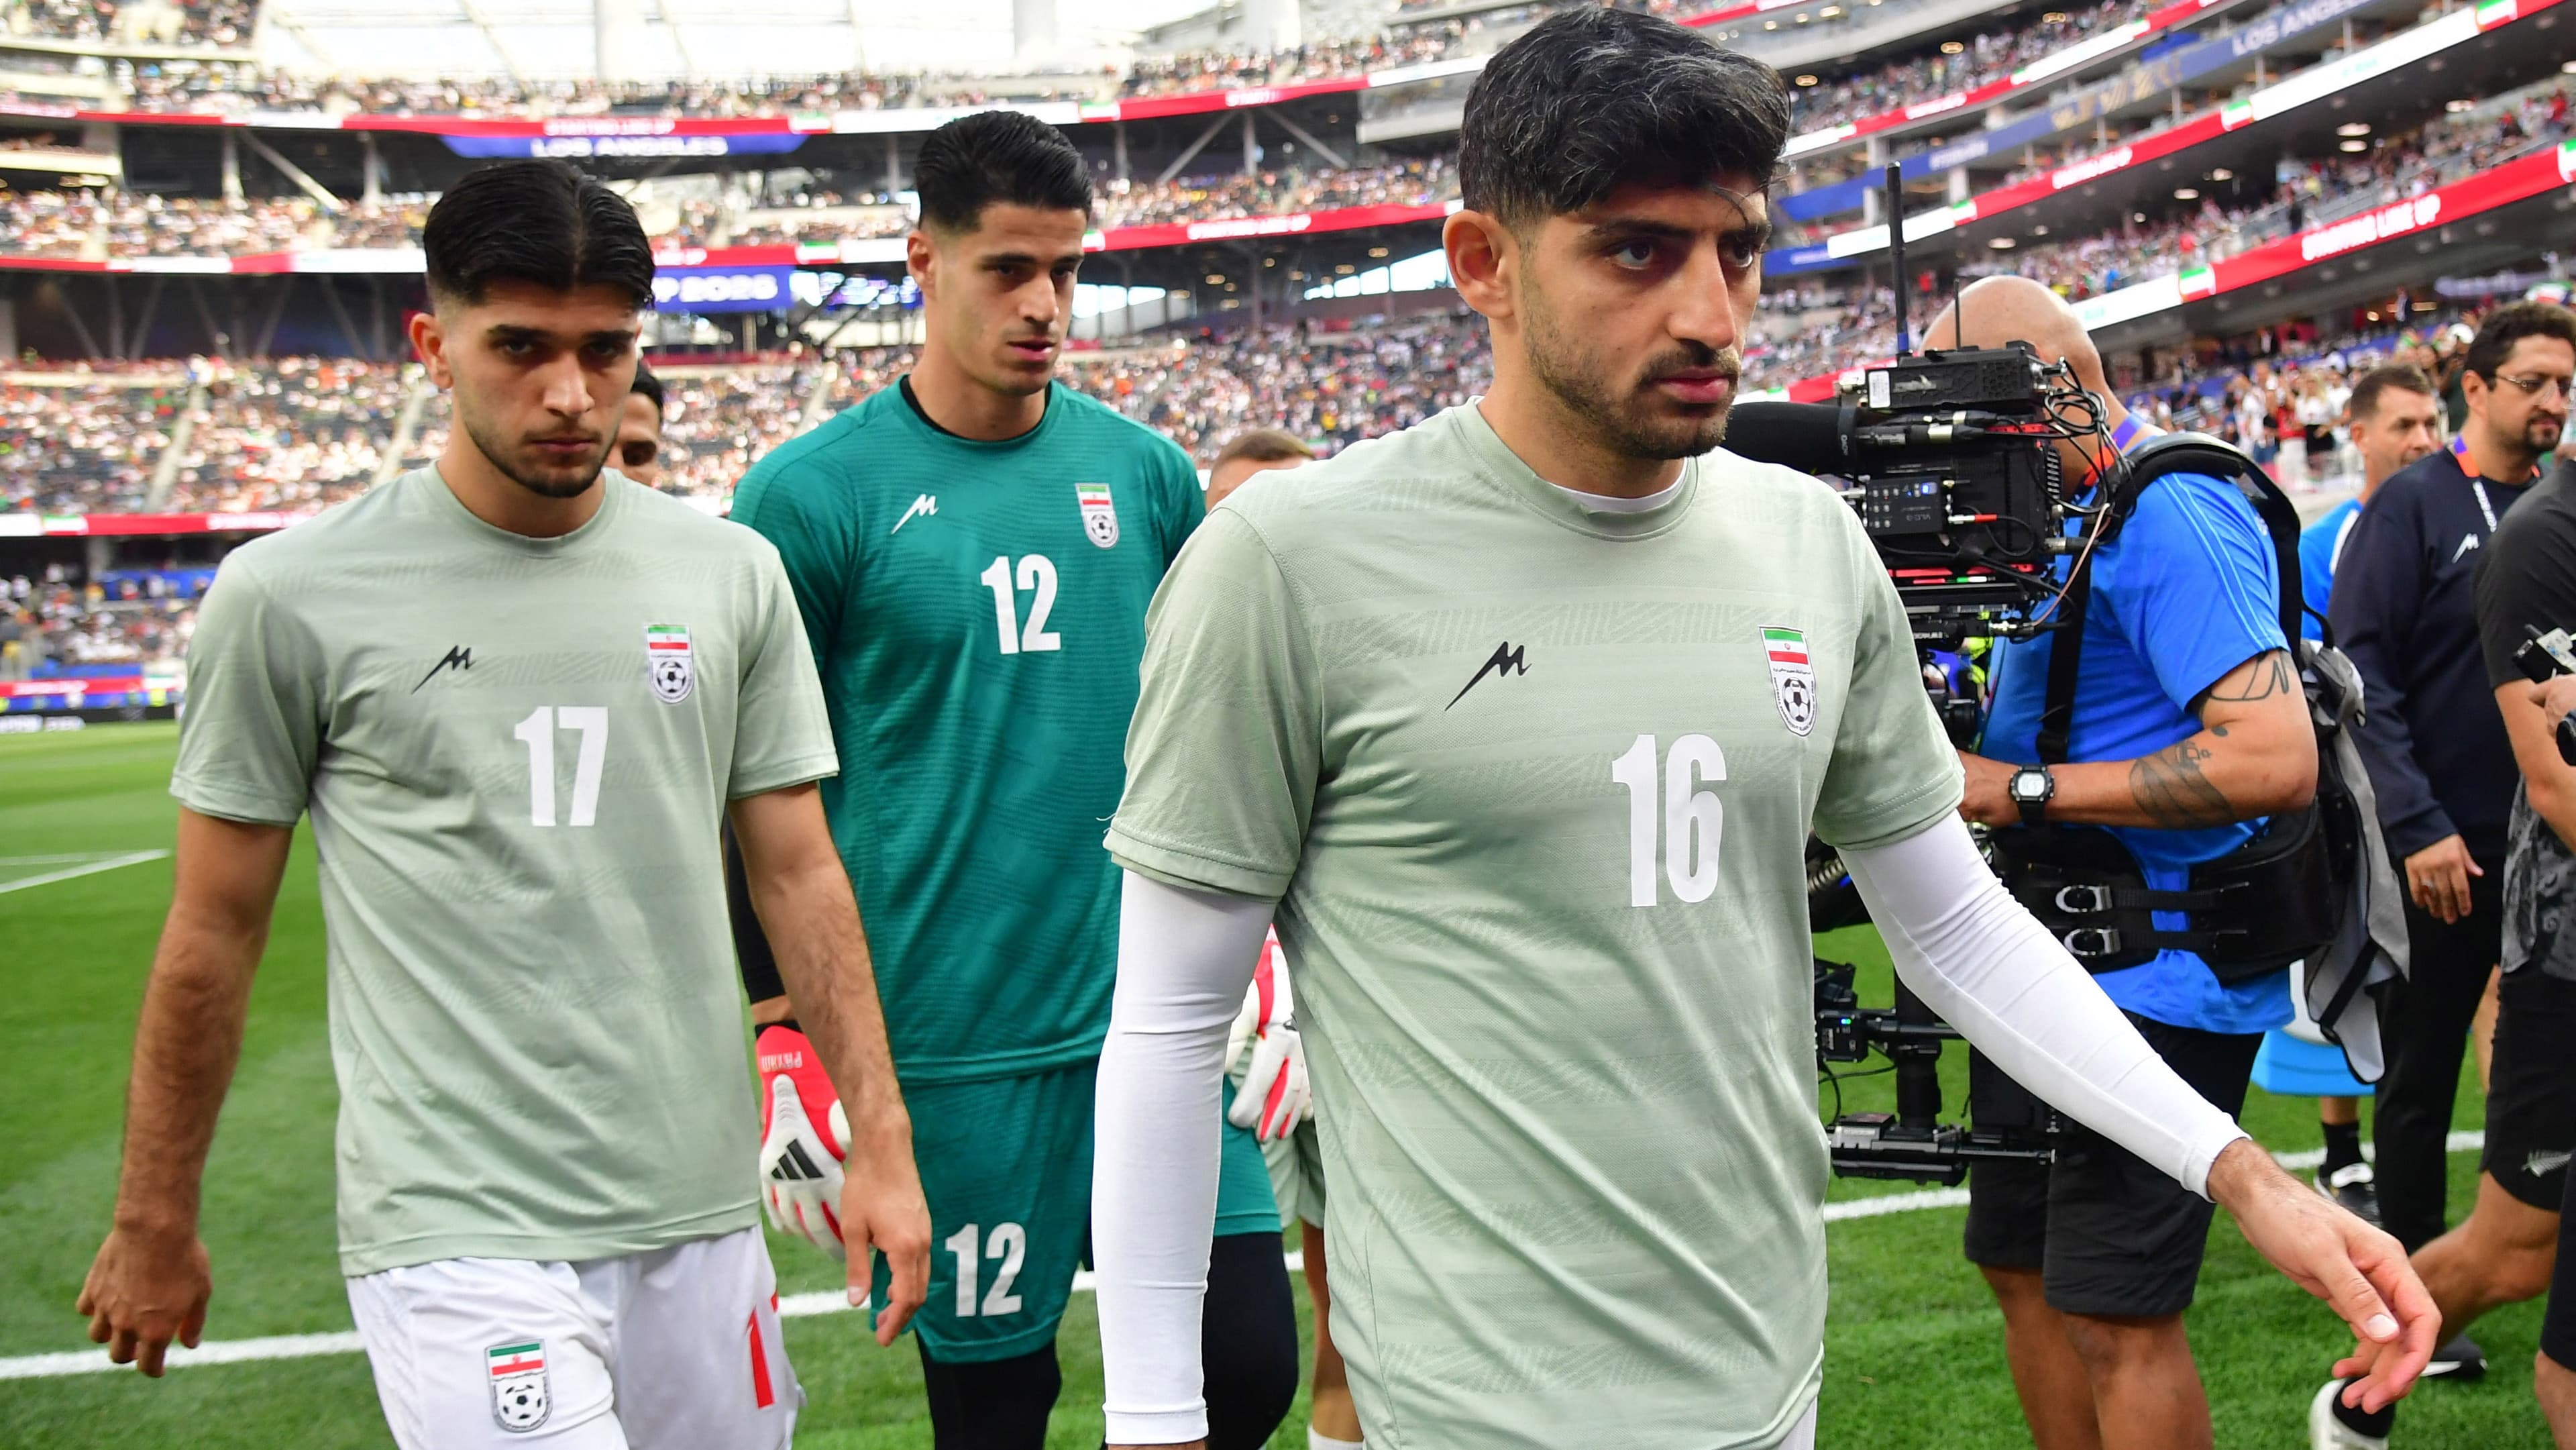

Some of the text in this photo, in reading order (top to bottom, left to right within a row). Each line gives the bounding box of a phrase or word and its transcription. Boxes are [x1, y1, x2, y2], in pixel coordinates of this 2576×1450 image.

[530, 136, 593, 158] LOS
[2377, 202, 2415, 238] LINE
[2415, 193, 2441, 225] UP
[981, 554, 1061, 654] 12
[514, 706, 608, 826] 17
[1611, 734, 1727, 907] 16
[945, 1222, 1026, 1318] 12
